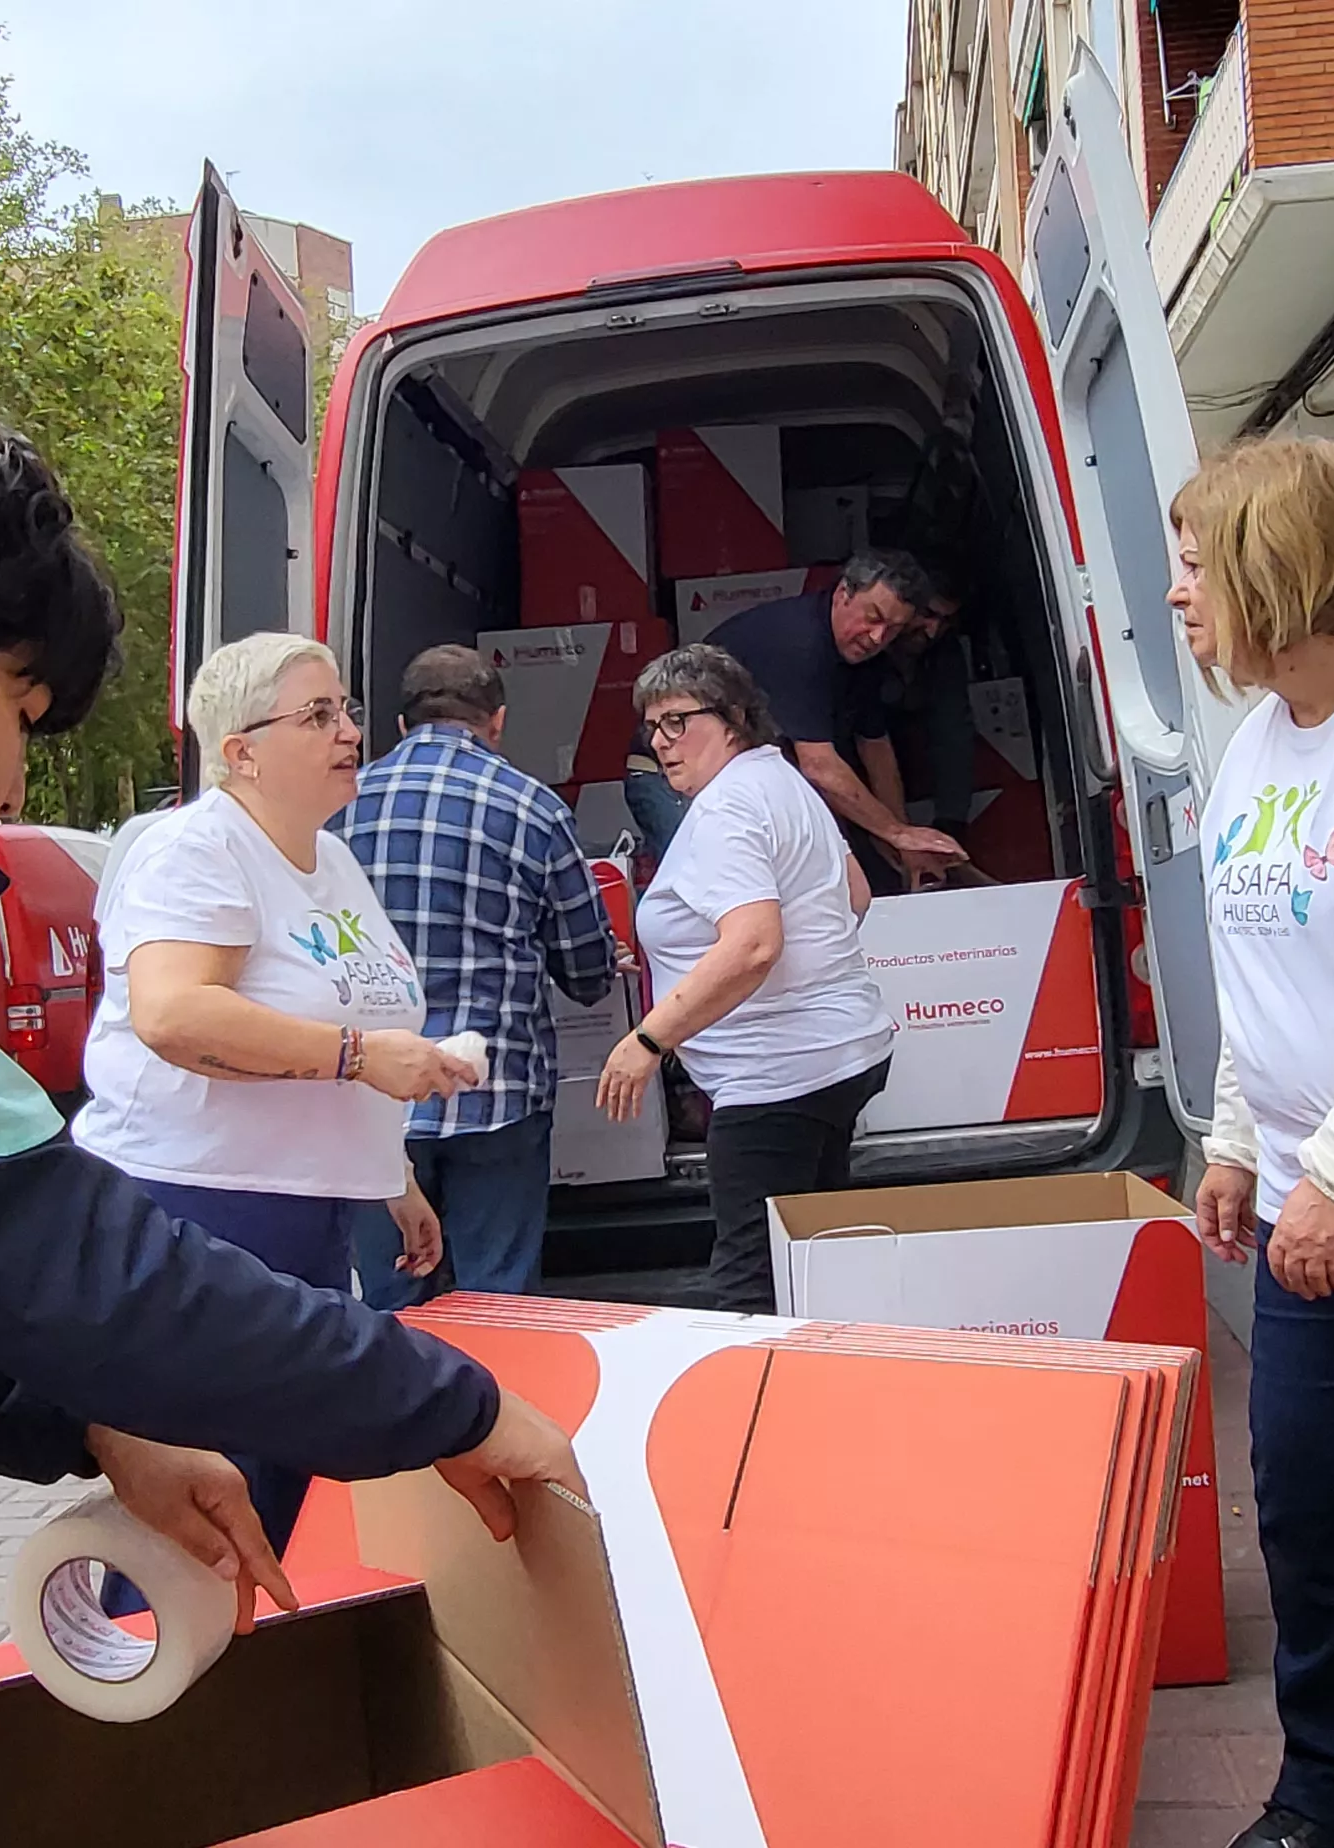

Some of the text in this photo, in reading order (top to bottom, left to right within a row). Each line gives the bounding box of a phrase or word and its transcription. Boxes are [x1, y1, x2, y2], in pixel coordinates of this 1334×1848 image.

[1215, 861, 1292, 896] ASAFA
[1223, 903, 1281, 923] HUESCA
[867, 945, 1017, 969] Productos veterinarios
[343, 960, 407, 986] ASAFA
[905, 998, 1005, 1021] Humeco
